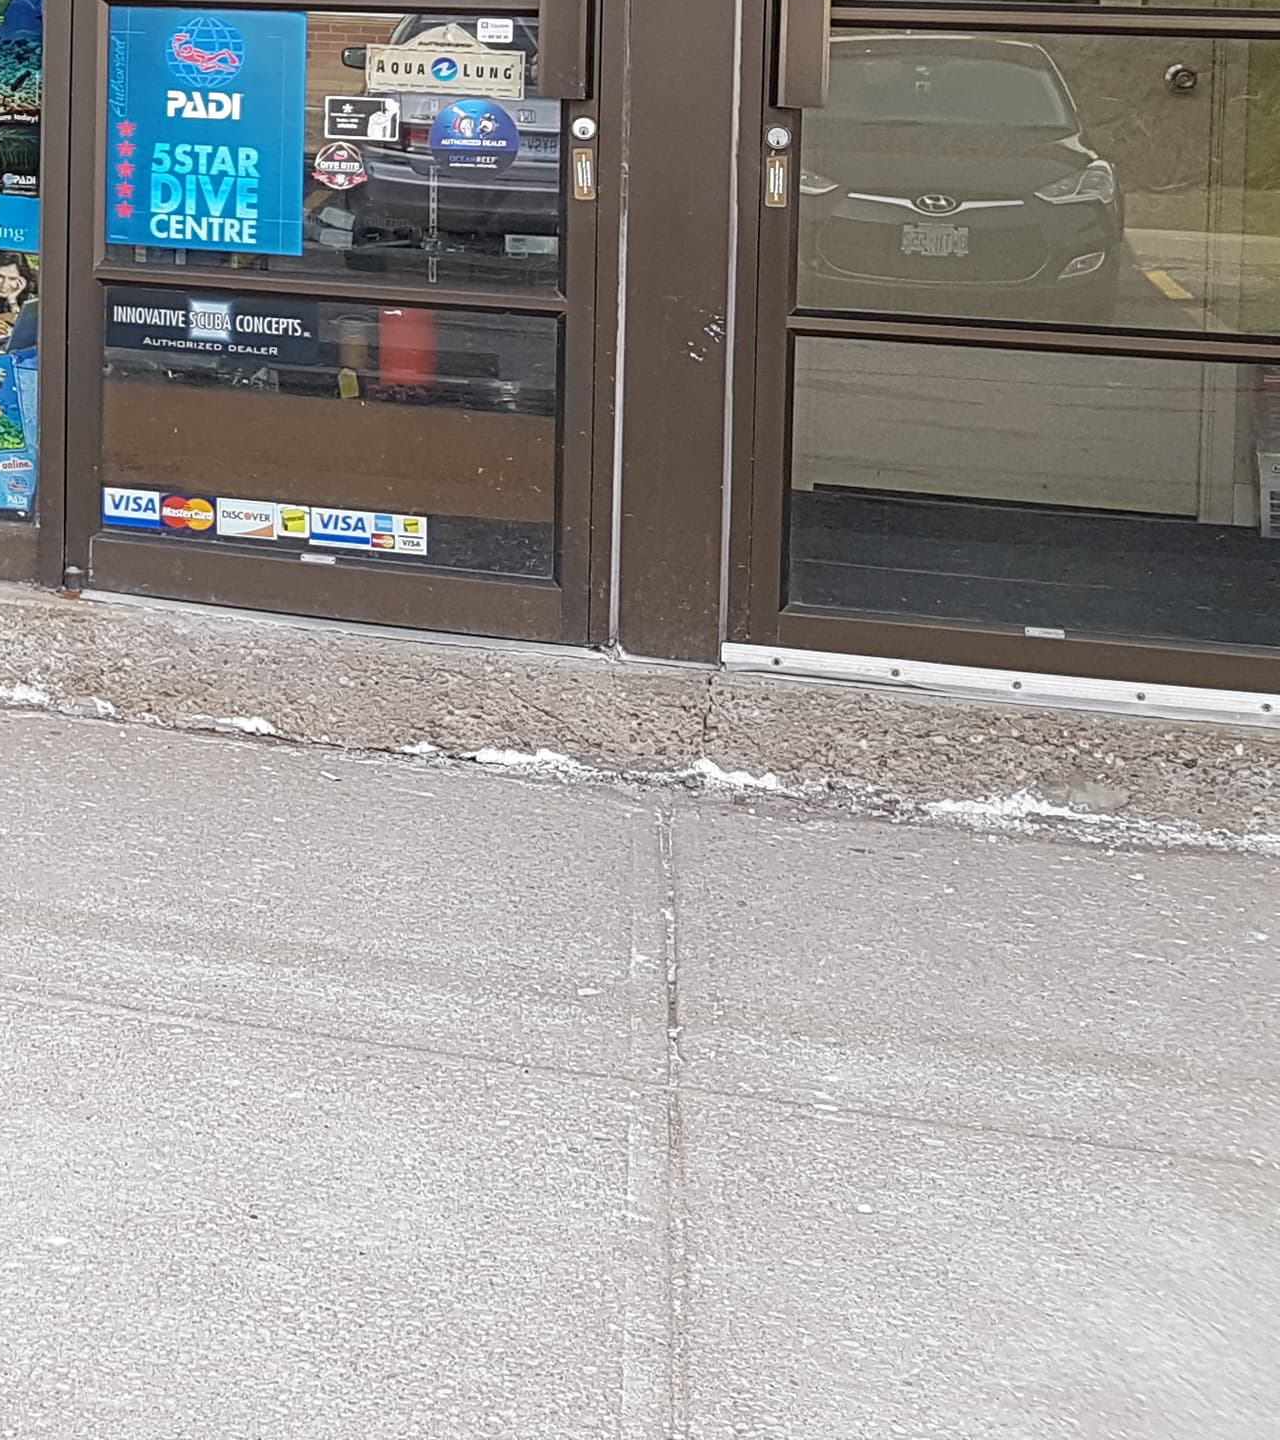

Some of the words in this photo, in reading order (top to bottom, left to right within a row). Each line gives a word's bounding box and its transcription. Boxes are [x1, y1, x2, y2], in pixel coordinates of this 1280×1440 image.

[376, 59, 426, 76] AQUA
[463, 63, 513, 80] LUNG
[166, 90, 241, 121] PADI
[441, 138, 482, 147] AUTHORIZED
[482, 139, 507, 147] DEALER
[320, 161, 340, 171] DIVE
[12, 175, 37, 185] PADI
[150, 172, 259, 220] DIVE
[149, 214, 257, 245] CENTRE
[113, 305, 186, 328] INNOVATIVE
[189, 311, 232, 331] SCUBA
[236, 314, 302, 337] CONCEPTS
[142, 336, 223, 352] AUTHORIZED
[228, 344, 279, 356] DEALER
[1, 460, 32, 470] online.
[107, 492, 157, 514] VISA
[161, 506, 216, 523] MasterCard
[221, 509, 272, 524] DISCOVER
[316, 511, 368, 534] VISA
[401, 538, 422, 548] VISA
